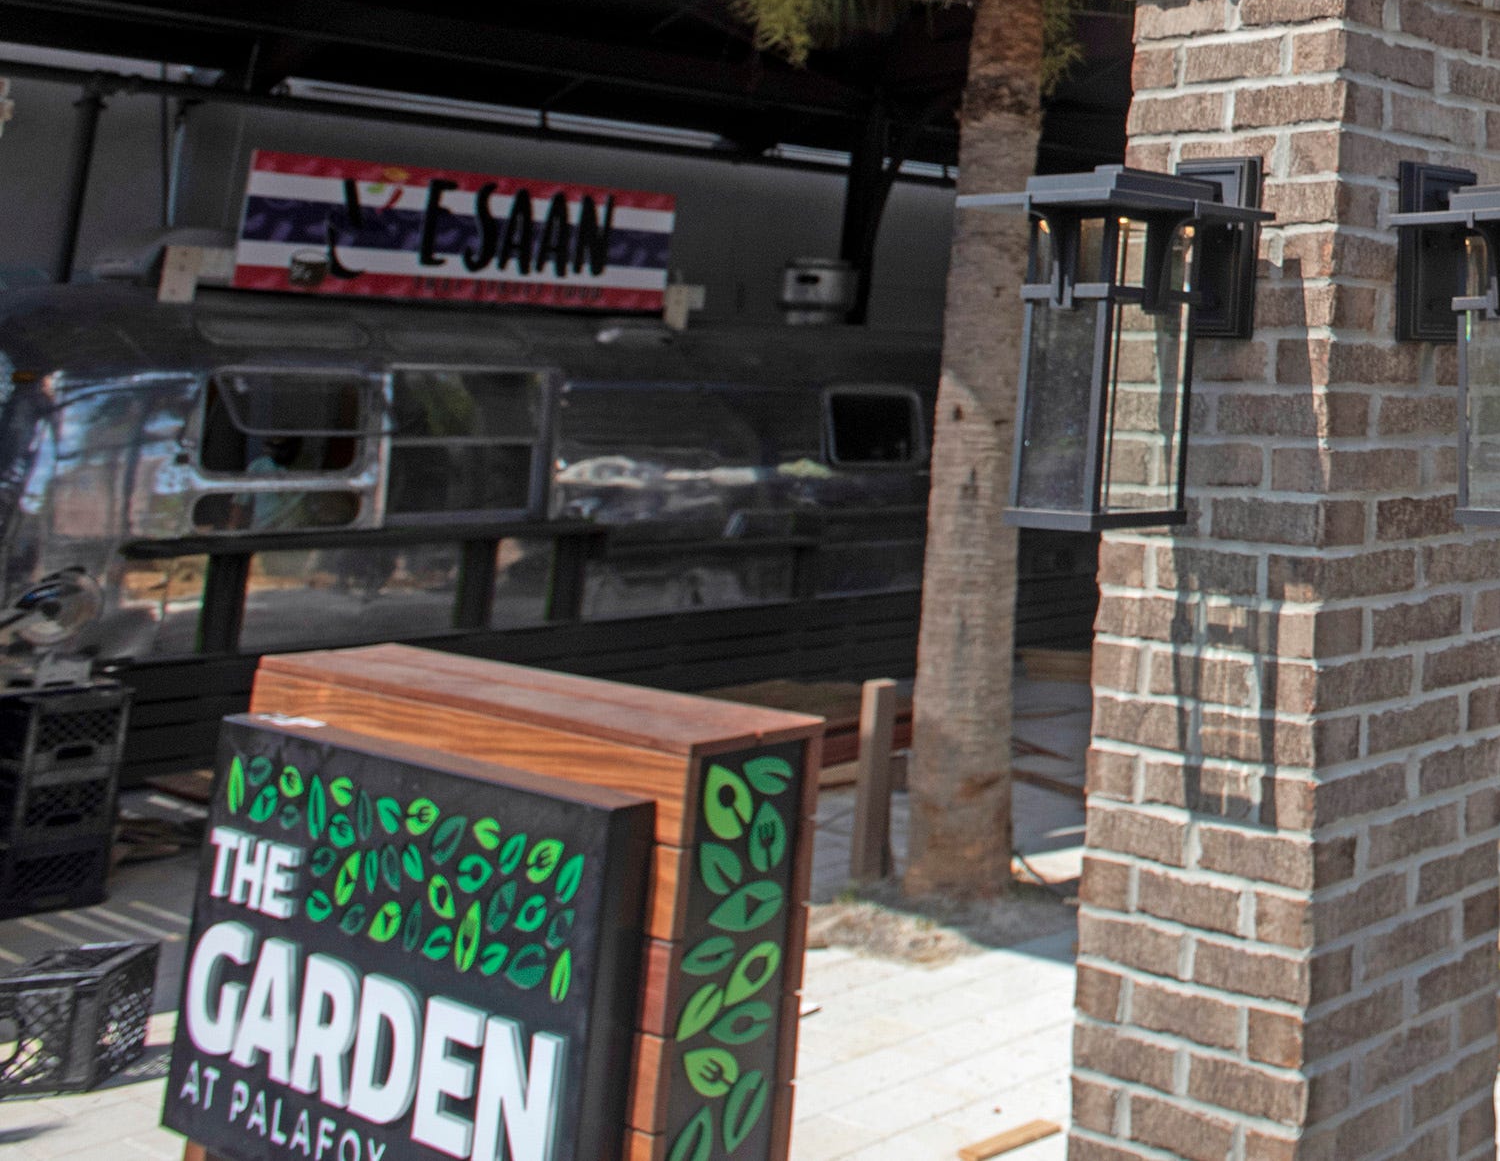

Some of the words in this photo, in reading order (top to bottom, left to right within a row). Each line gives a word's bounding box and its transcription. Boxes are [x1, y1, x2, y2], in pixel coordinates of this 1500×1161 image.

[210, 825, 303, 920] THE
[179, 1059, 221, 1111] AT
[186, 921, 568, 1161] GARDEN
